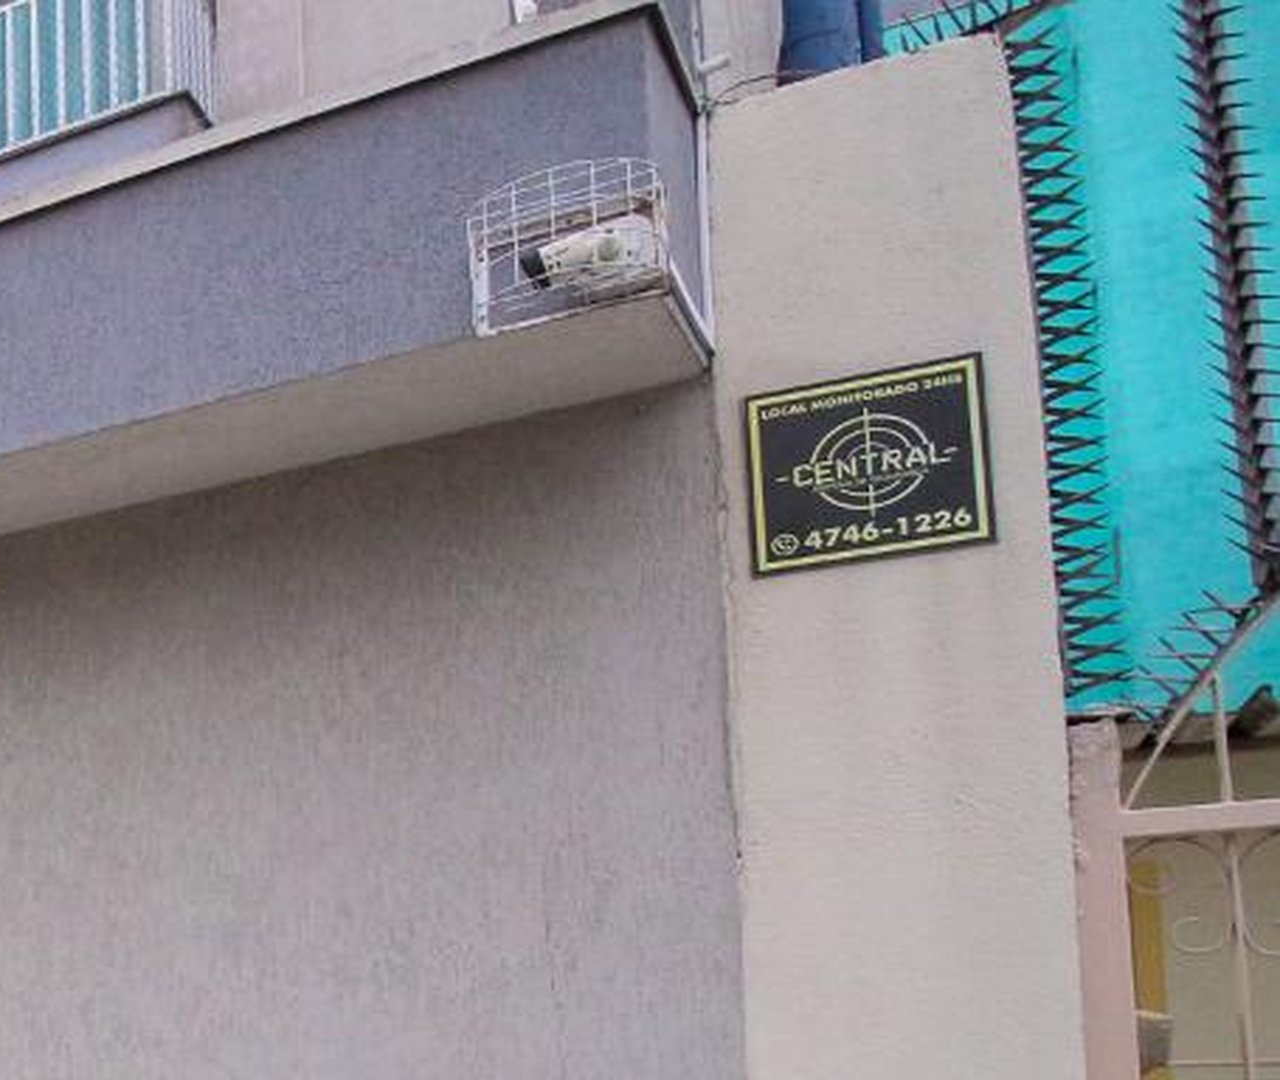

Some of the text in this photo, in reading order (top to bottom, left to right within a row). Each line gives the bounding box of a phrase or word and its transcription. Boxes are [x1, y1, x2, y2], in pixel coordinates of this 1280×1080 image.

[760, 403, 808, 421] LOCAL
[810, 384, 919, 411] MONITORADO
[792, 441, 952, 488] CENTRAL
[804, 507, 972, 549] 4746-1226
